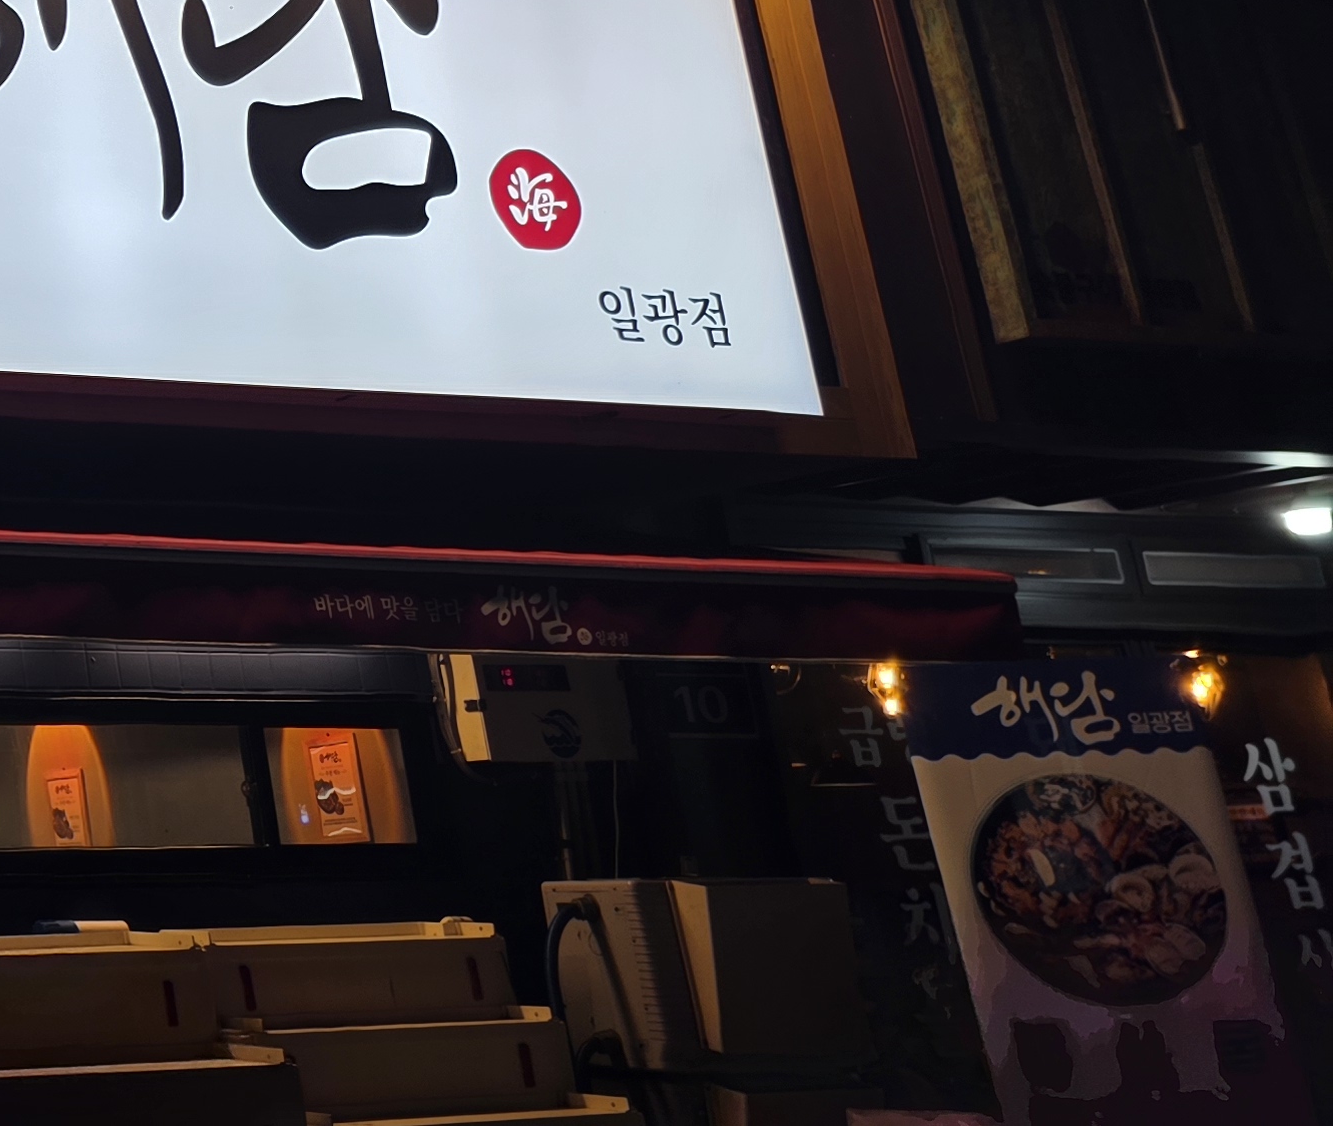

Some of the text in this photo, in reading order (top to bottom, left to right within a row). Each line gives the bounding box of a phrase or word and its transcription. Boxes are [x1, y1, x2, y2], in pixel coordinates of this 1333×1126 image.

[507, 167, 568, 231] 海
[599, 286, 731, 348] 일광점
[314, 594, 374, 619] 바다에
[380, 596, 418, 622] 맛을
[424, 599, 464, 624] 담다
[481, 584, 572, 645] 해담
[674, 685, 728, 723] 10
[970, 670, 1194, 745] 해담 일광점
